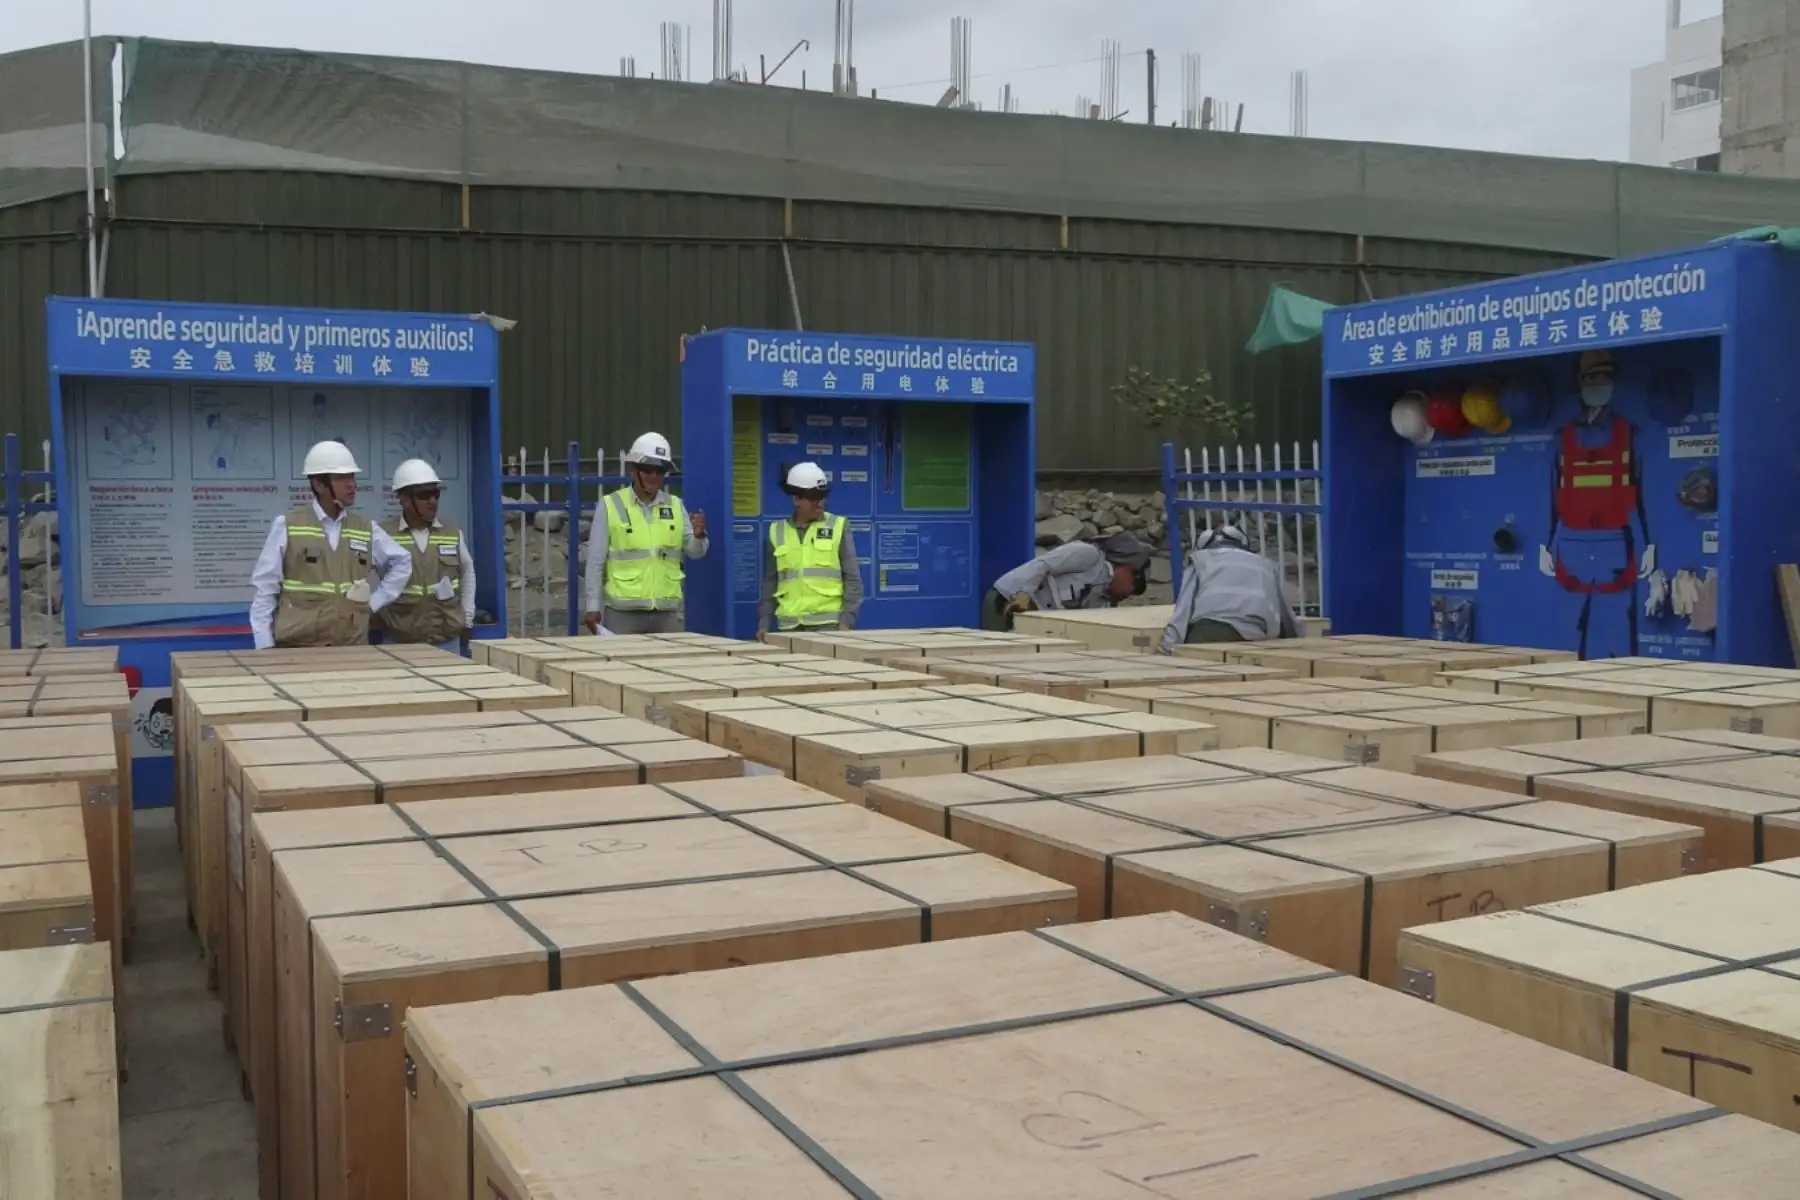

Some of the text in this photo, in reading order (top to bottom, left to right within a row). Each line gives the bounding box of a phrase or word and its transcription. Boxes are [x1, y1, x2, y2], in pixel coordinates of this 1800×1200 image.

[1342, 263, 1705, 342] Área de exhibición de equipos de protección
[180, 315, 284, 349] seguridad
[288, 325, 300, 351] y
[304, 319, 390, 351] primeros
[395, 323, 475, 352] auxilios!
[1368, 306, 1663, 365] 安全防护用品展示区体验
[130, 347, 430, 377] 安全急救培训体验
[747, 338, 1019, 373] Práctica de seguridad eléctrica
[782, 369, 985, 394] 综合用电体验
